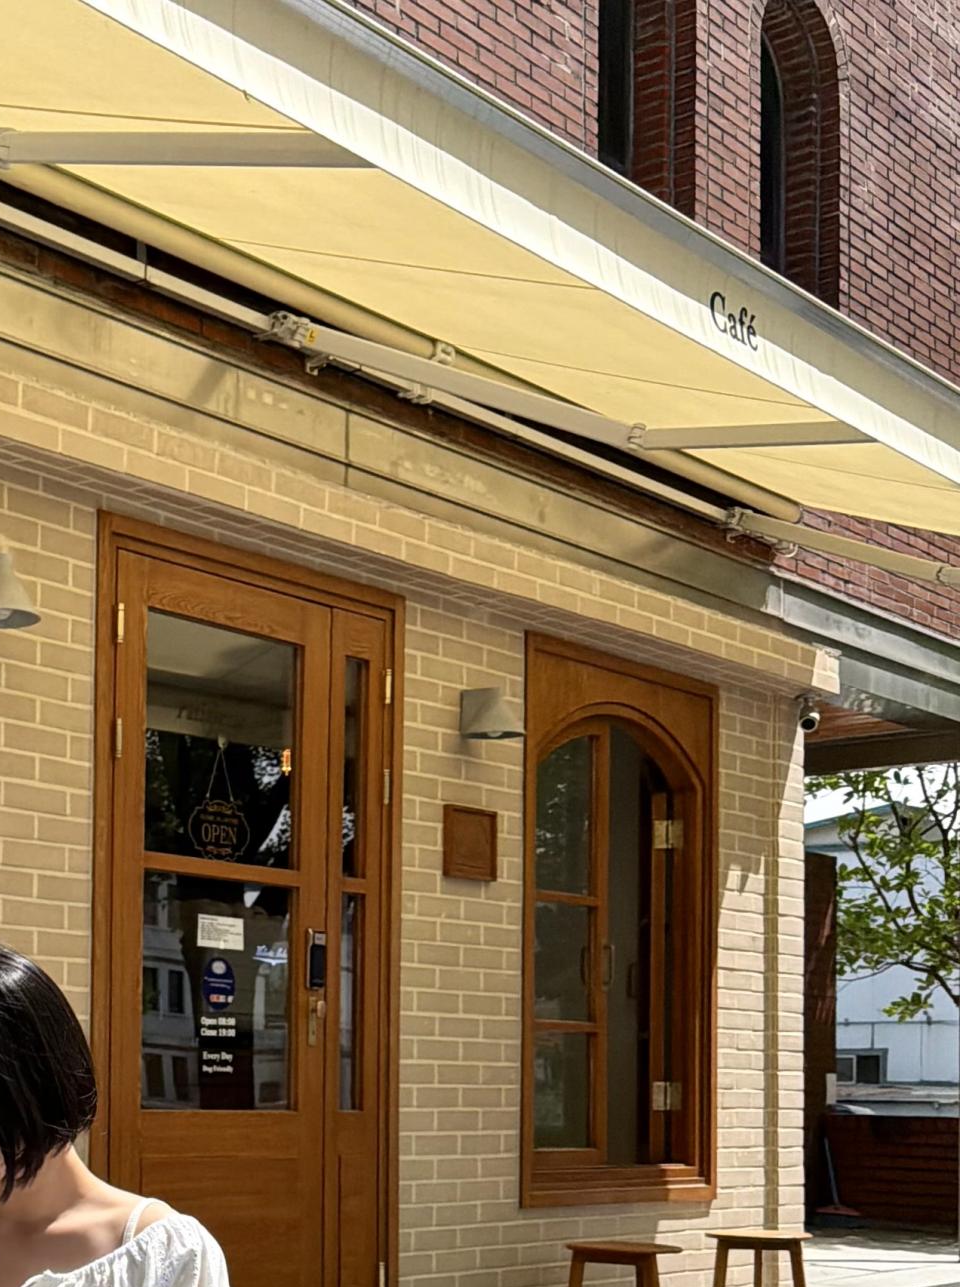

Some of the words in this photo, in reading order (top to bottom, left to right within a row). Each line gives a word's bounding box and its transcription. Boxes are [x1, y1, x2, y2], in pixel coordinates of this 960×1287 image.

[709, 291, 758, 351] Café
[201, 823, 237, 845] OPEN
[200, 1016, 217, 1027] Open
[202, 1051, 220, 1062] Every
[220, 1051, 233, 1063] Day
